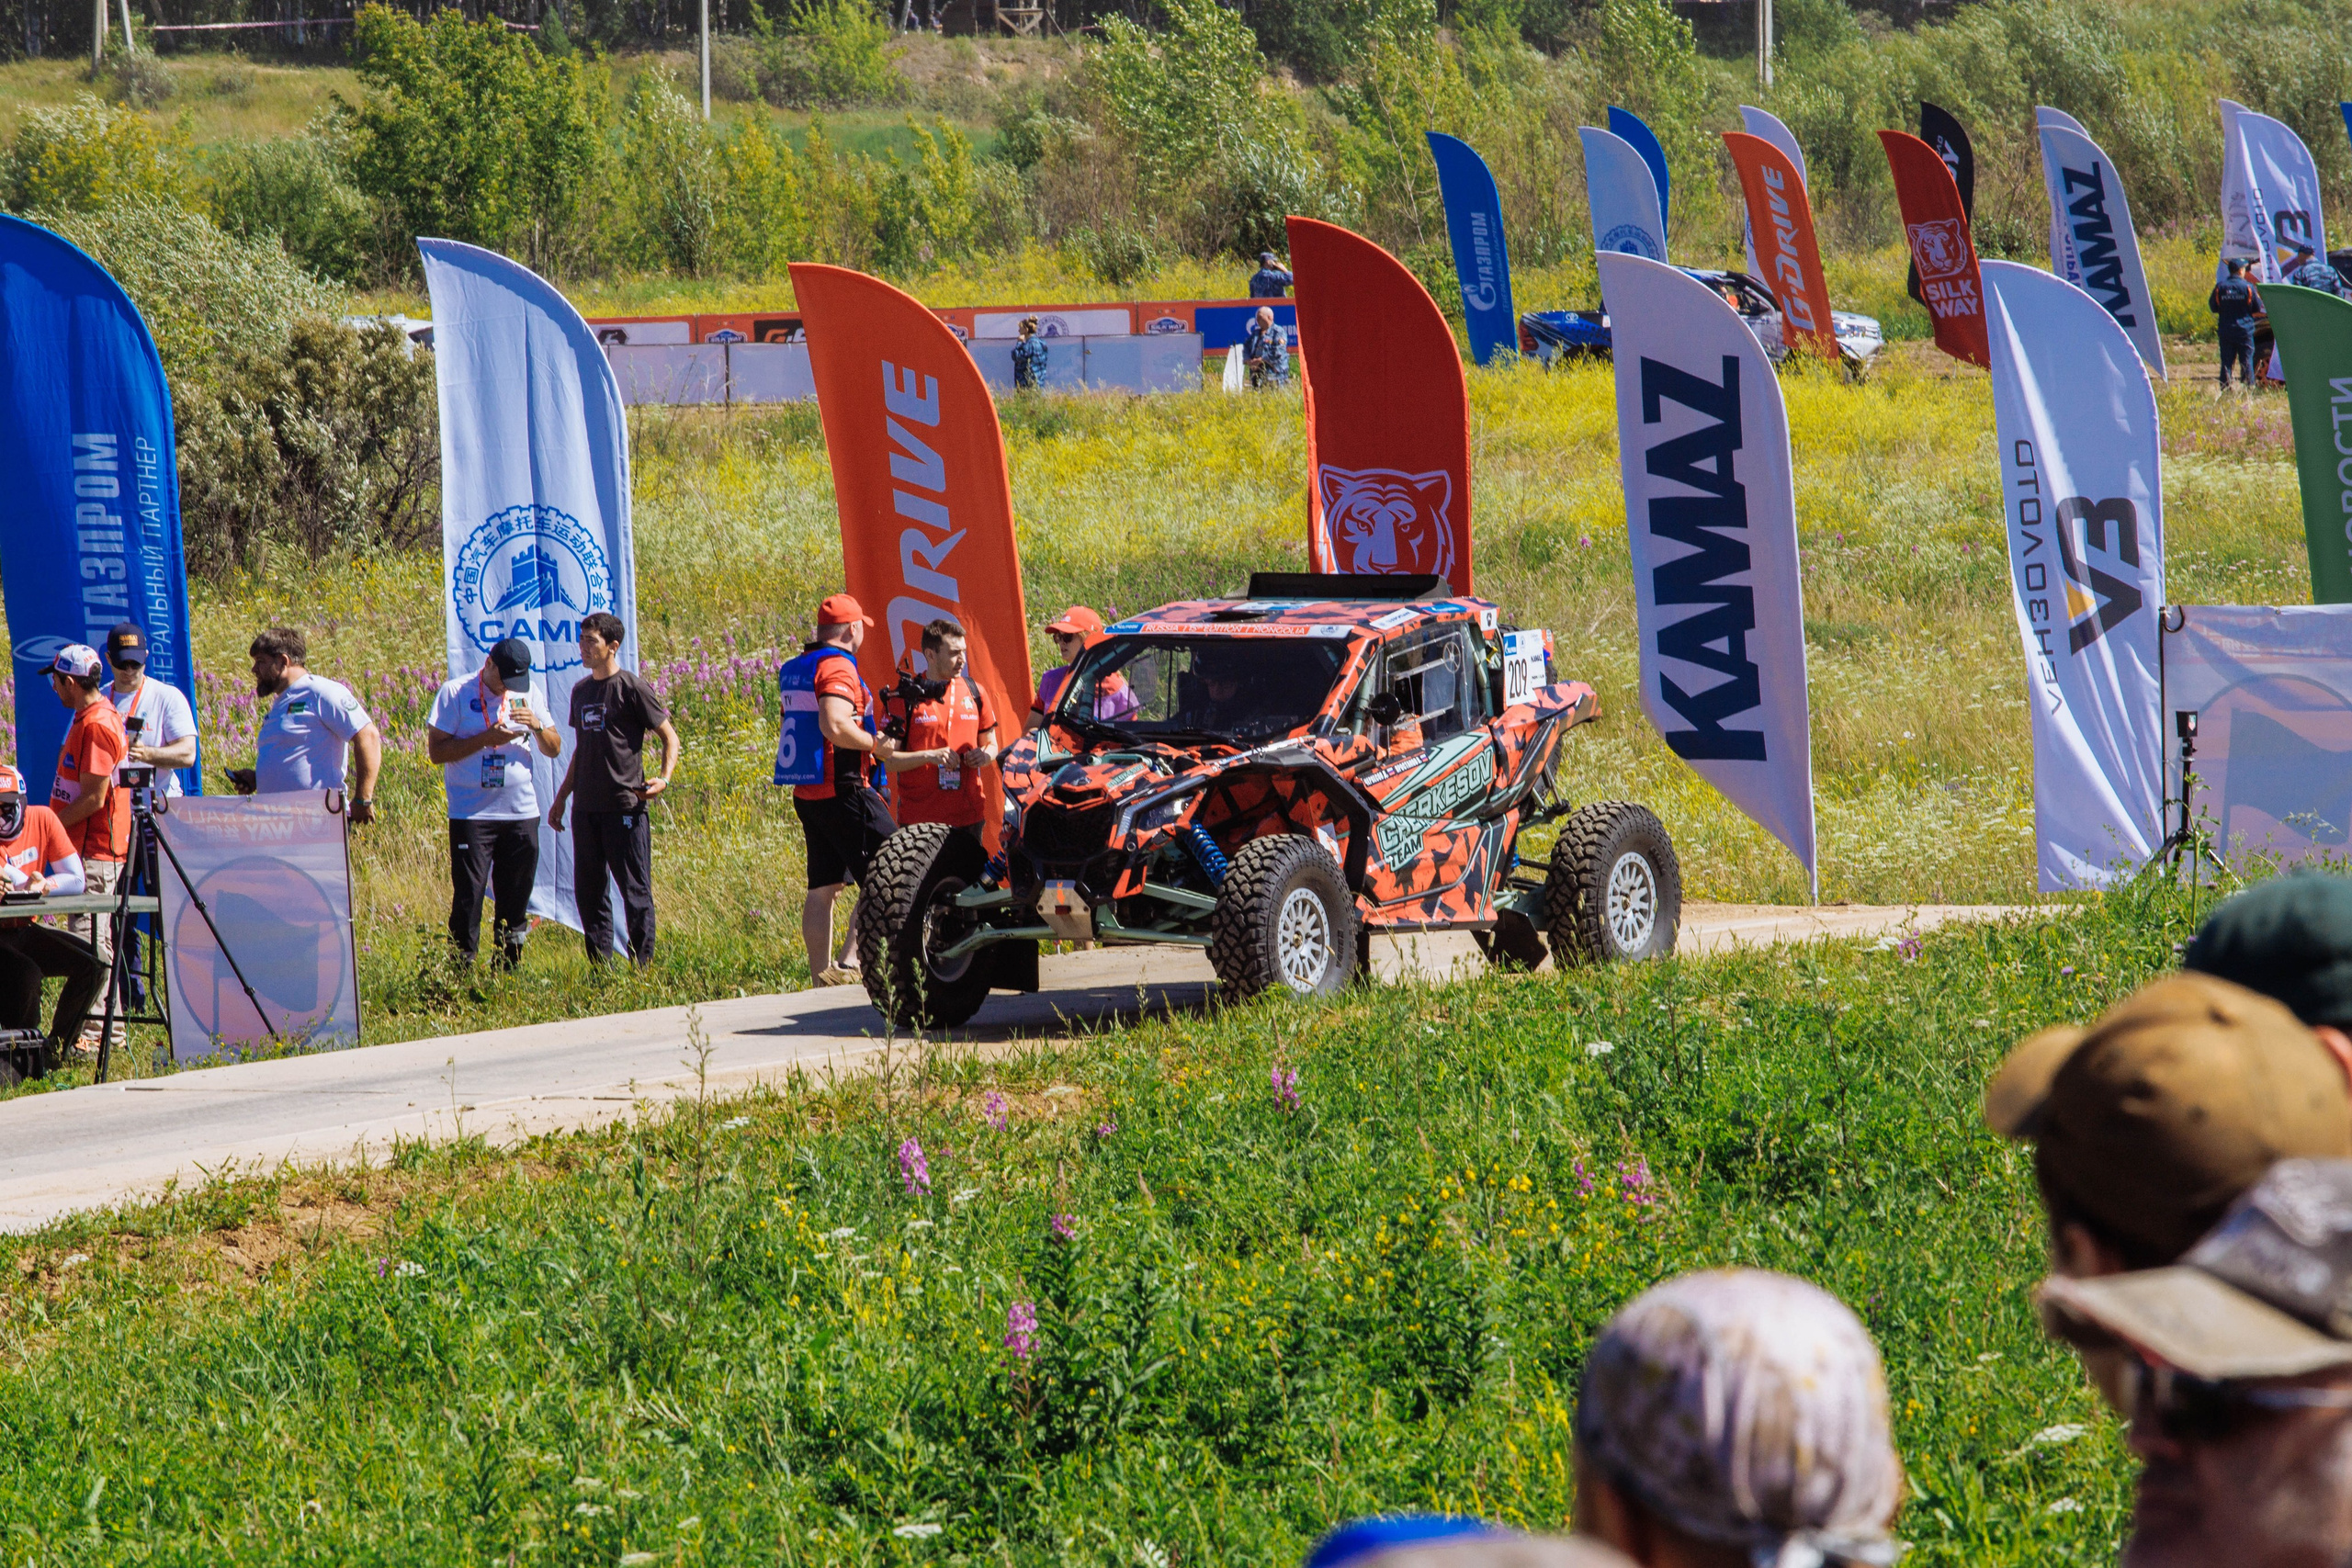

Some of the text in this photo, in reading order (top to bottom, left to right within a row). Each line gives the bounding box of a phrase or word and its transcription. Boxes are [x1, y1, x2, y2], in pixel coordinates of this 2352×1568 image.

[1470, 211, 1495, 282] ГАЗПРОМ
[1926, 278, 1977, 301] SILK
[1931, 297, 1979, 319] WAY
[72, 433, 130, 625] ГАЗПРОМ
[135, 435, 175, 685] НЕРАЛЬНЫЙ ПАРТНЕР
[1640, 355, 1768, 761] KAMAZ
[463, 514, 607, 610] 中国汽车摩托车运动联合会
[1145, 624, 1179, 632] RUSSIA
[1252, 625, 1306, 635] MONGOLIA
[1509, 659, 1528, 699] 209
[777, 716, 797, 769] 6
[1377, 746, 1494, 852] CHERKESOV
[1385, 837, 1423, 868] TEAM
